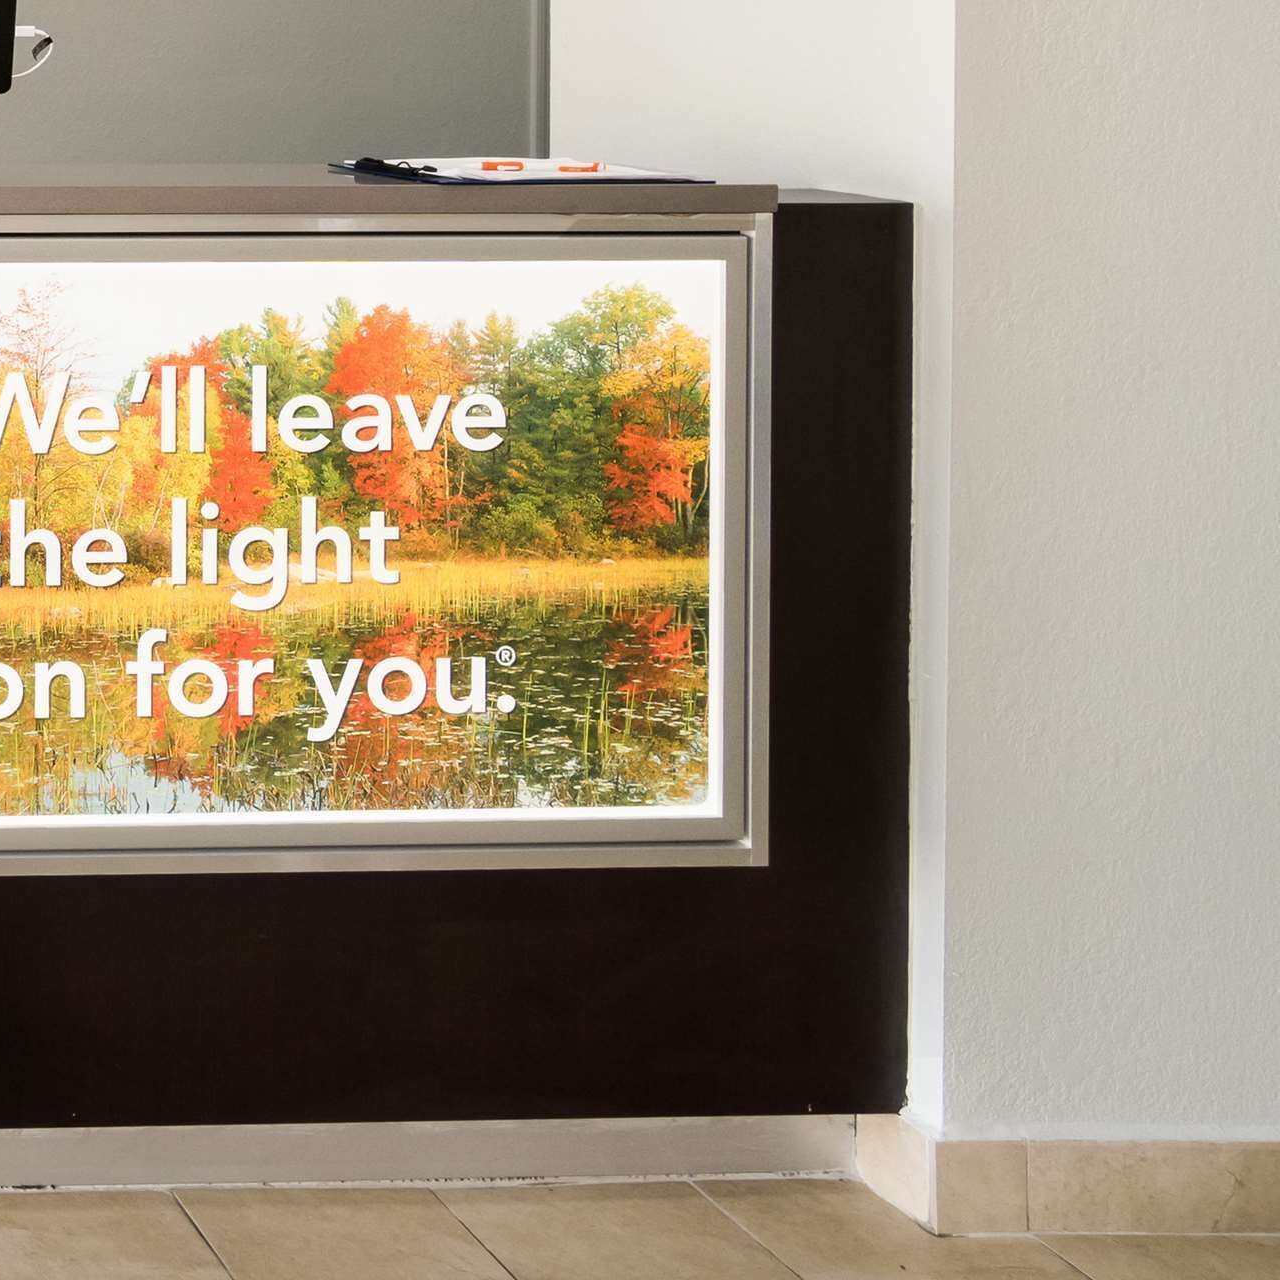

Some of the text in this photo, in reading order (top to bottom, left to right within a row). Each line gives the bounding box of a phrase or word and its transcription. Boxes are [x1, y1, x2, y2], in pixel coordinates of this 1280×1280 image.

[251, 365, 508, 454] leave
[170, 496, 401, 611] light
[126, 629, 274, 719] for
